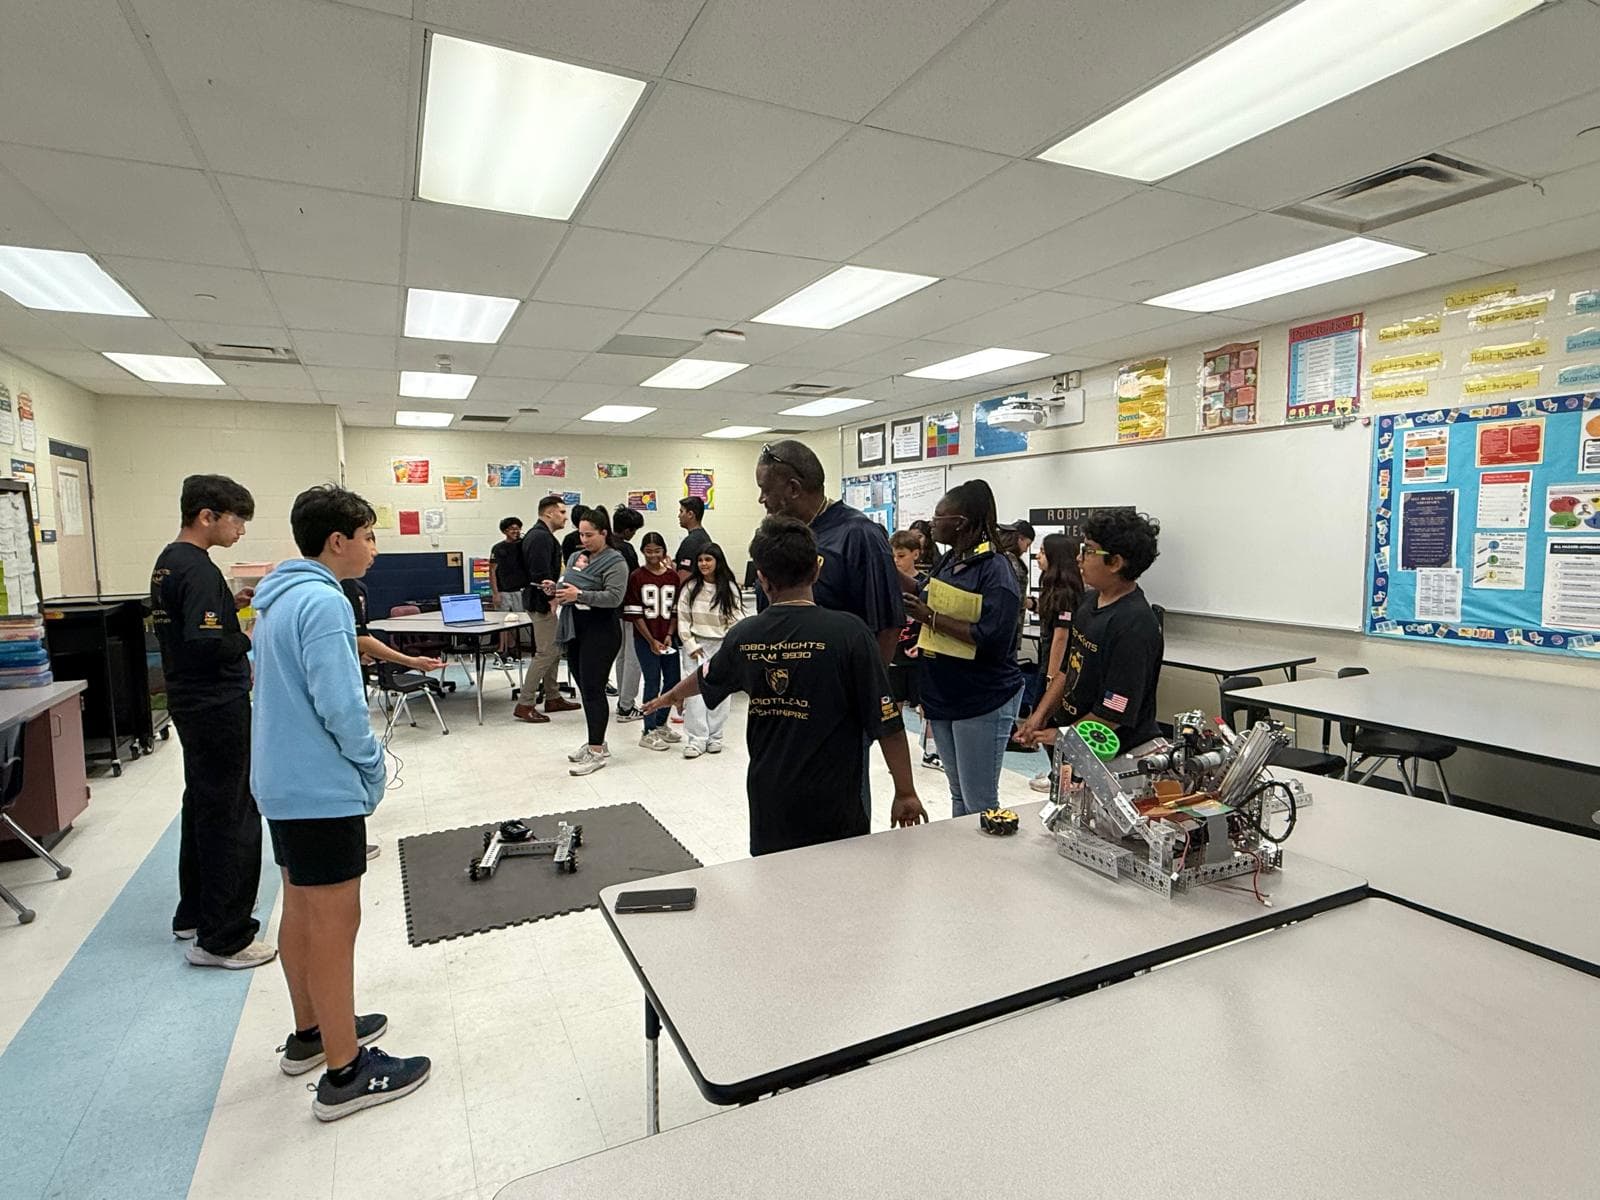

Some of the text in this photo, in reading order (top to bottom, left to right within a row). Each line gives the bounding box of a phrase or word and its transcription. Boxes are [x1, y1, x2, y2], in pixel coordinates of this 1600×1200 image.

[641, 583, 676, 620] 98
[739, 641, 826, 652] ROBO-KNIGHTS
[746, 653, 778, 662] TEAM
